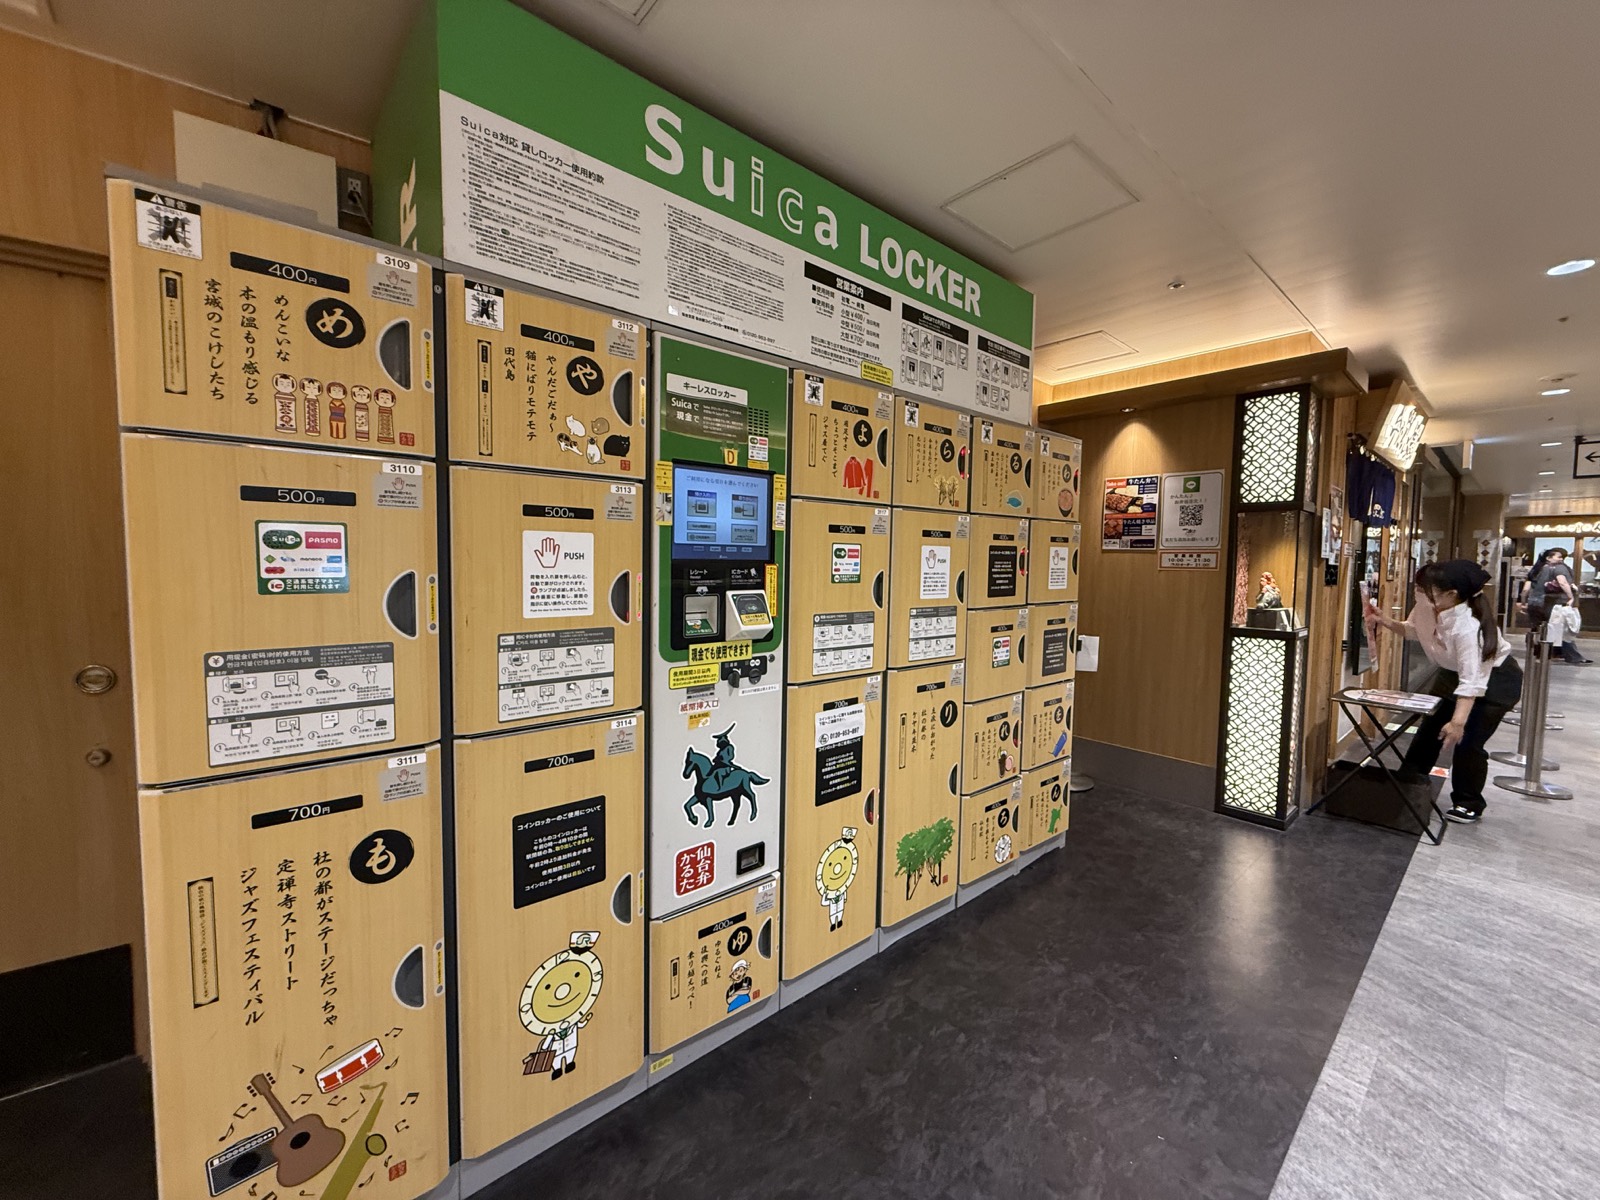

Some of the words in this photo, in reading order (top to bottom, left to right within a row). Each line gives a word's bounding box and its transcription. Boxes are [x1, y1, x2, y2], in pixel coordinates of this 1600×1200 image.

[461, 116, 518, 148] Suica対応
[644, 104, 839, 250] Suica
[860, 223, 982, 318] LOCKER
[384, 256, 410, 270] 3109
[268, 264, 318, 286] 400円
[274, 294, 290, 362] めんこいな
[316, 308, 354, 338] め
[617, 321, 634, 331] 3112
[203, 278, 225, 401] 宮城のこけしたち
[239, 286, 260, 405] 木の温もり感じる
[544, 331, 575, 346] 400円
[504, 347, 516, 381] 田代島
[571, 363, 598, 390] や
[525, 351, 537, 442] 猫にばりモテモテ
[683, 382, 736, 399] キーレスロッカー
[676, 411, 699, 423] 現金で
[842, 404, 858, 414] 400円
[858, 424, 868, 442] よ
[727, 450, 734, 464] D
[944, 443, 952, 459] ら
[390, 464, 415, 474] 3110
[277, 490, 324, 504] 500円
[545, 507, 574, 518] 500円
[564, 552, 584, 560] PUSH
[691, 644, 750, 662] 現金でも使用できます
[616, 719, 632, 727] 3114
[945, 705, 953, 724] り
[1001, 725, 1008, 738] れ
[396, 755, 418, 766] 3111
[548, 756, 574, 767] 700円
[288, 804, 330, 821] 700円
[517, 805, 601, 831] コインロッカーのご使用について
[533, 826, 588, 844] こちらのコインロッカーは
[365, 838, 396, 875] も
[695, 846, 711, 885] 仙台弁
[542, 860, 581, 876] 使用期間3日以内
[679, 853, 696, 893] かるた
[525, 865, 596, 891] コインロッカー使用は前払いです
[277, 858, 298, 990] 定禅寺ストリート
[712, 918, 734, 932] 400円
[240, 867, 264, 1026] ジャズフェスティバル
[313, 851, 338, 1026] 杜の都がステージだっちゃ
[732, 931, 748, 951] ゆ
